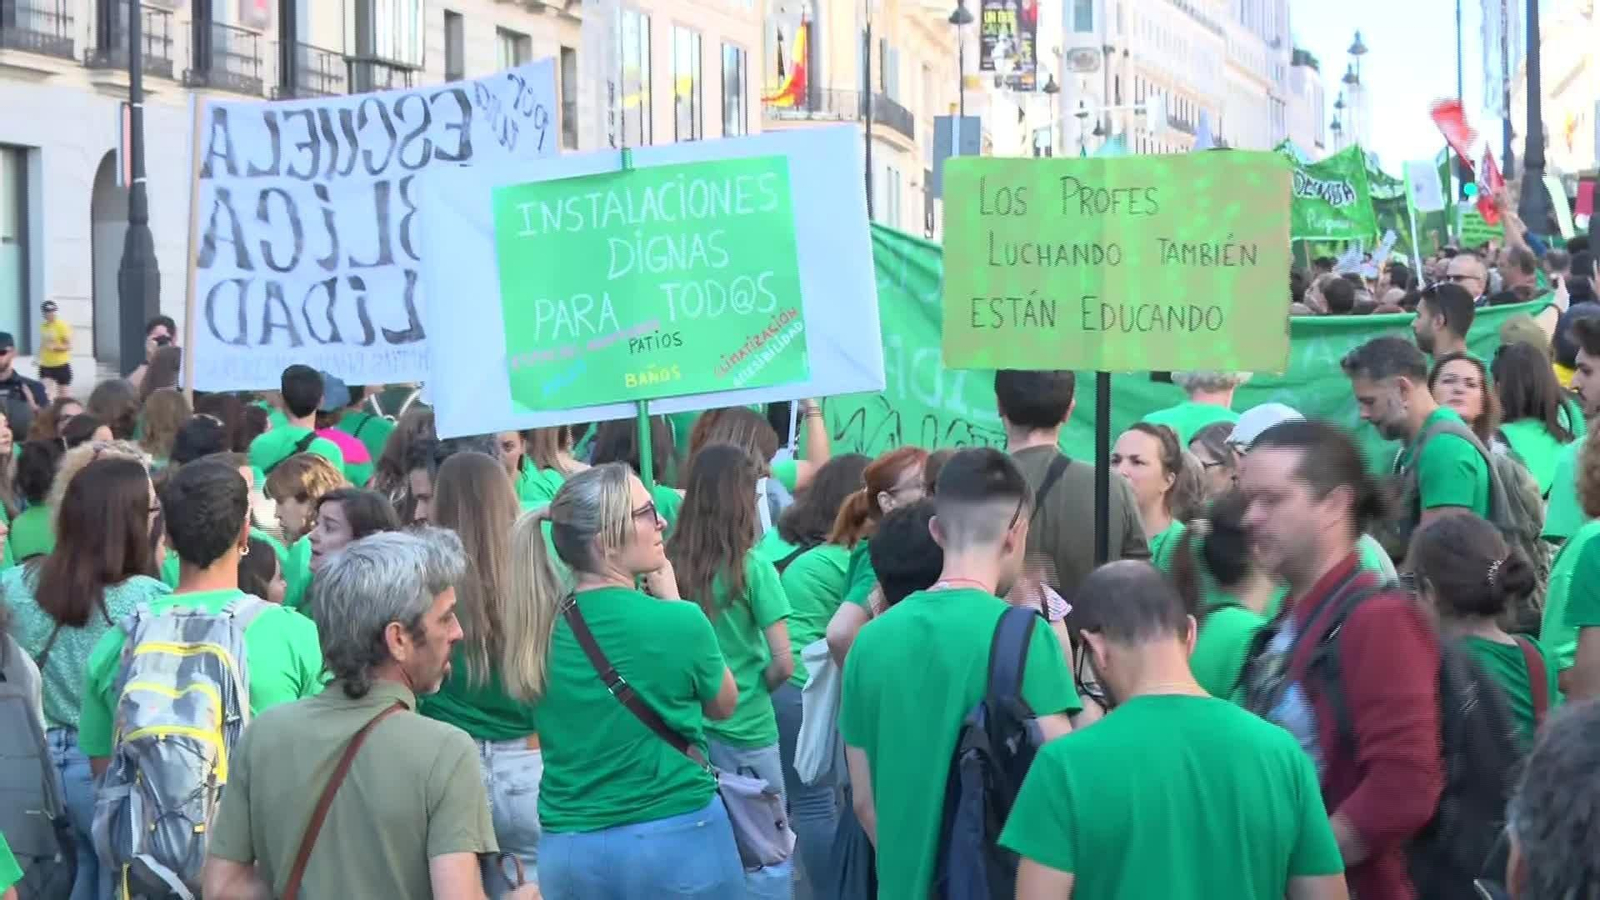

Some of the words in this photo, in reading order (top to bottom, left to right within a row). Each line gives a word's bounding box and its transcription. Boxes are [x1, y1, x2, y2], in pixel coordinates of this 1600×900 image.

[515, 172, 779, 237] INSTALACIONES
[1060, 176, 1161, 216] PROFES
[607, 229, 730, 281] DIGNAS
[988, 230, 1122, 267] LUCHANDO
[1157, 233, 1258, 267] TAMBIÉN
[533, 292, 620, 341] PARA
[659, 271, 777, 322] TOD@S
[970, 290, 1057, 329] ESTÁN
[1081, 296, 1224, 333] EDUCANDO
[628, 331, 683, 355] PATIOS
